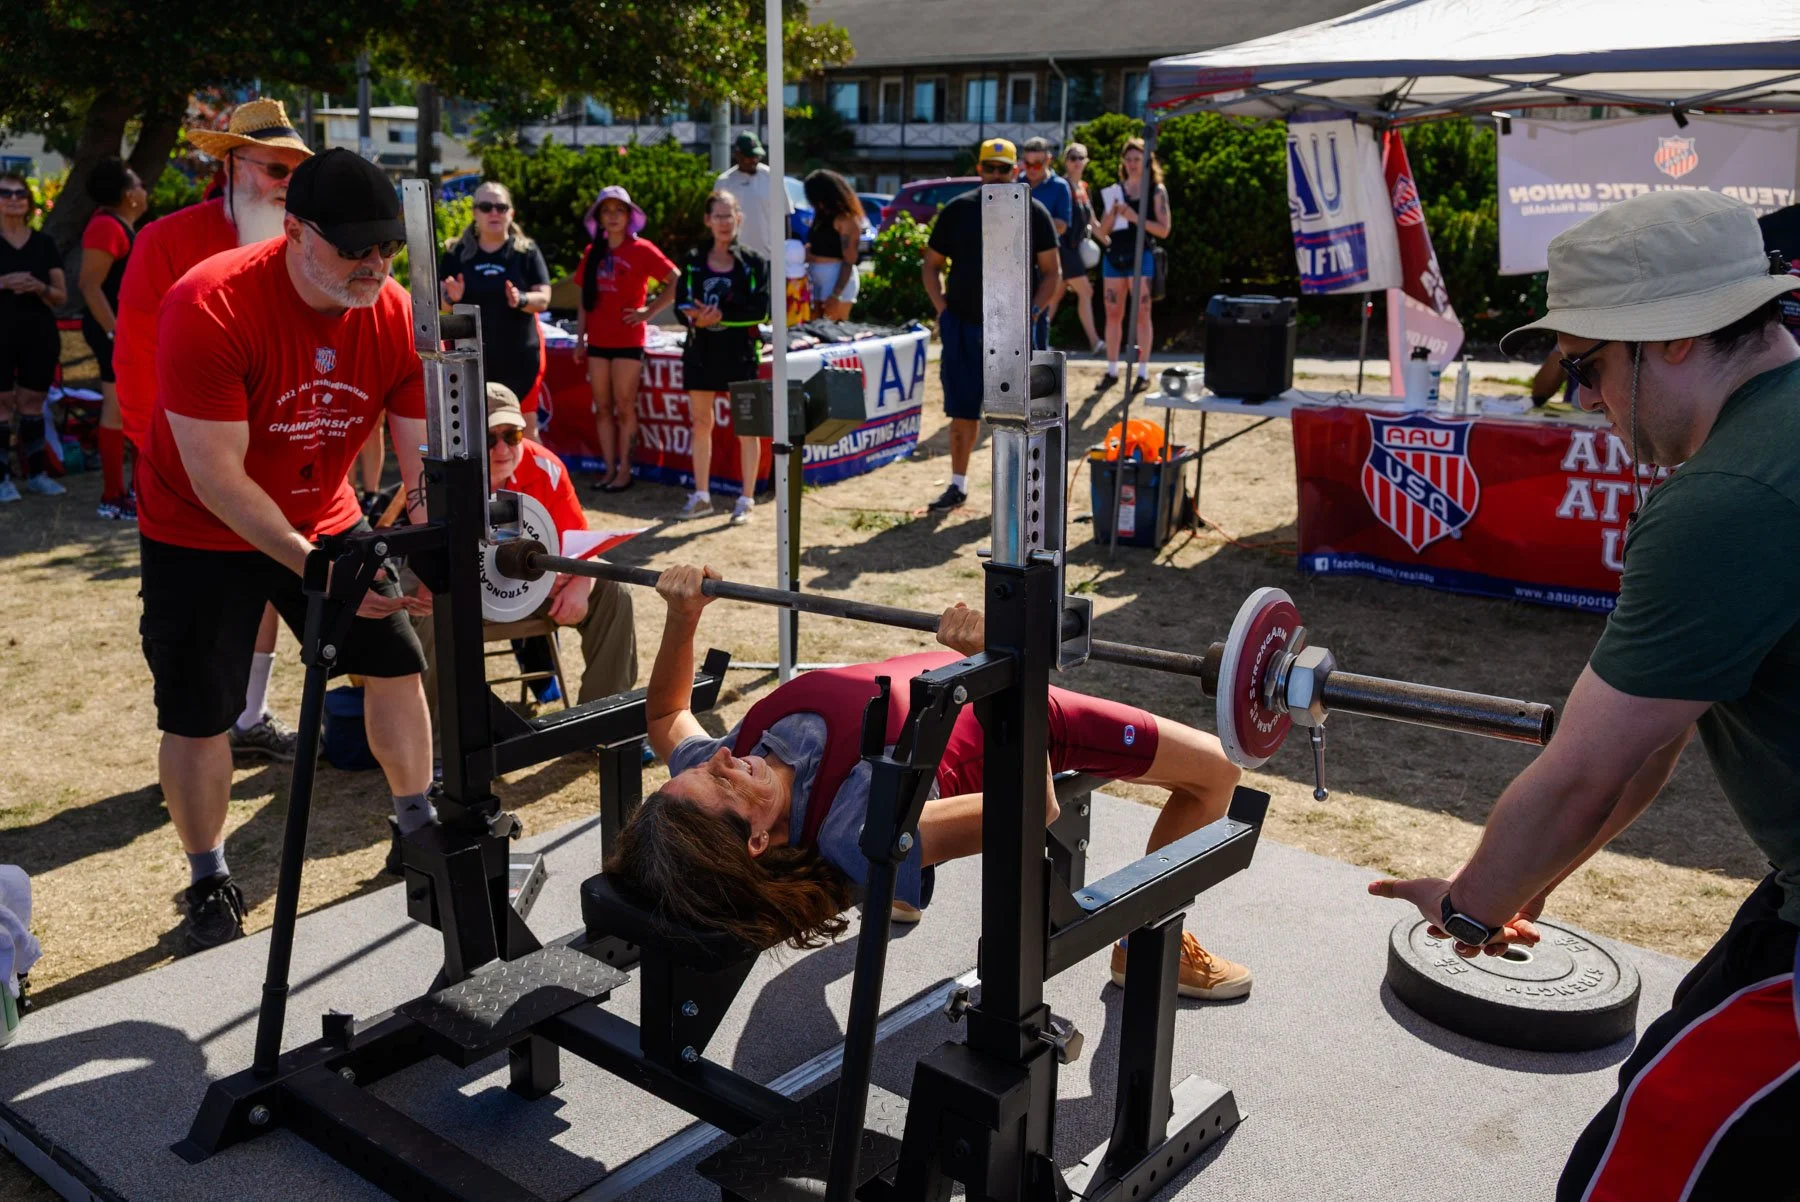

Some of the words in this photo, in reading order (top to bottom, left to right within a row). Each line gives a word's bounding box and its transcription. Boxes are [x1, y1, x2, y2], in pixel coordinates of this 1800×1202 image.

[276, 389, 297, 406] 2022
[313, 379, 355, 393] ashington
[269, 417, 363, 433] CHAMPONSHPS
[640, 423, 693, 455] NIO
[1387, 427, 1450, 448] AAU
[1386, 455, 1448, 521] USA
[1249, 626, 1287, 700] STRONGARM
